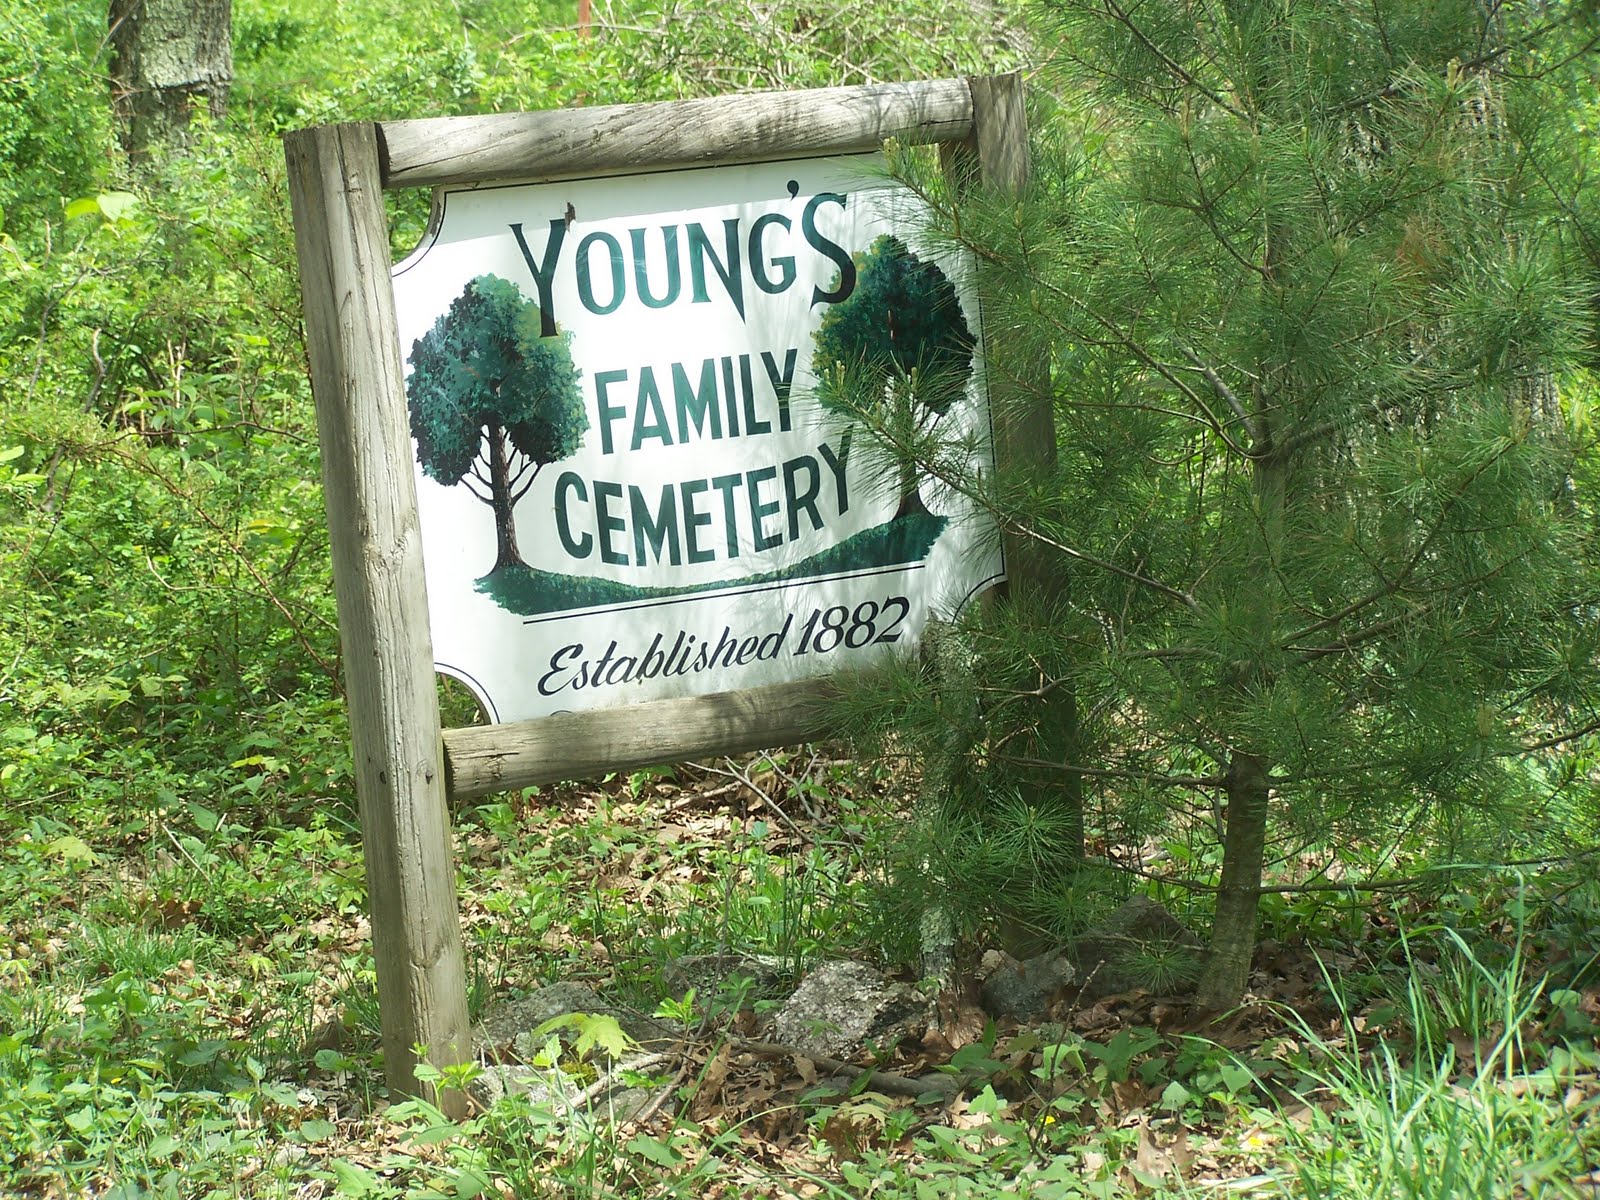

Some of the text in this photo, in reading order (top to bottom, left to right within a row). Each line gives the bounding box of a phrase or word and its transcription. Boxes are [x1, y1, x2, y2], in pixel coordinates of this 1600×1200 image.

[509, 180, 857, 338] YOUNG'S
[595, 348, 799, 456] FAMILY
[554, 423, 854, 567] CEMETERY
[538, 596, 911, 697] Established 1882
